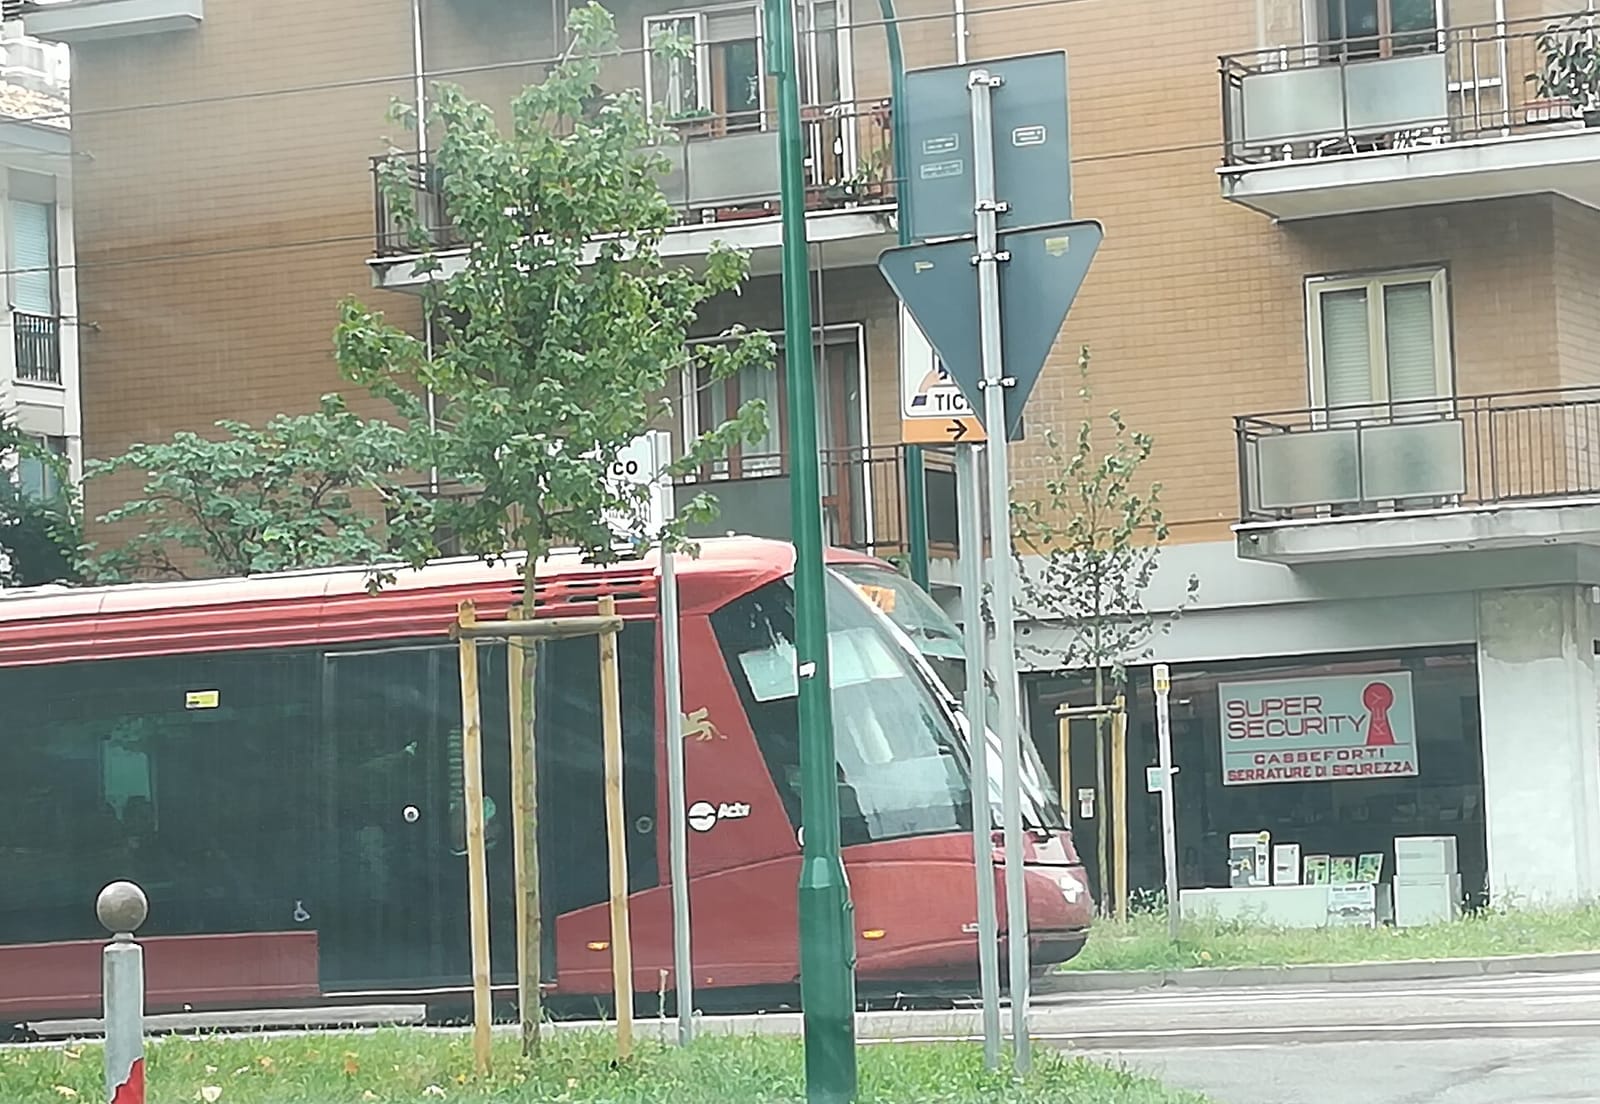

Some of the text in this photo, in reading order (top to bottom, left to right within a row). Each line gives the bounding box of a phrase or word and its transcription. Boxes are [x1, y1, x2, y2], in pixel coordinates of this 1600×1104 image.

[1227, 696, 1322, 719] SUPER
[1227, 714, 1366, 740] SECURITY
[1254, 748, 1385, 765] CASSEFORTI
[1227, 761, 1413, 782] SERRATURE DI SICUREZZA
